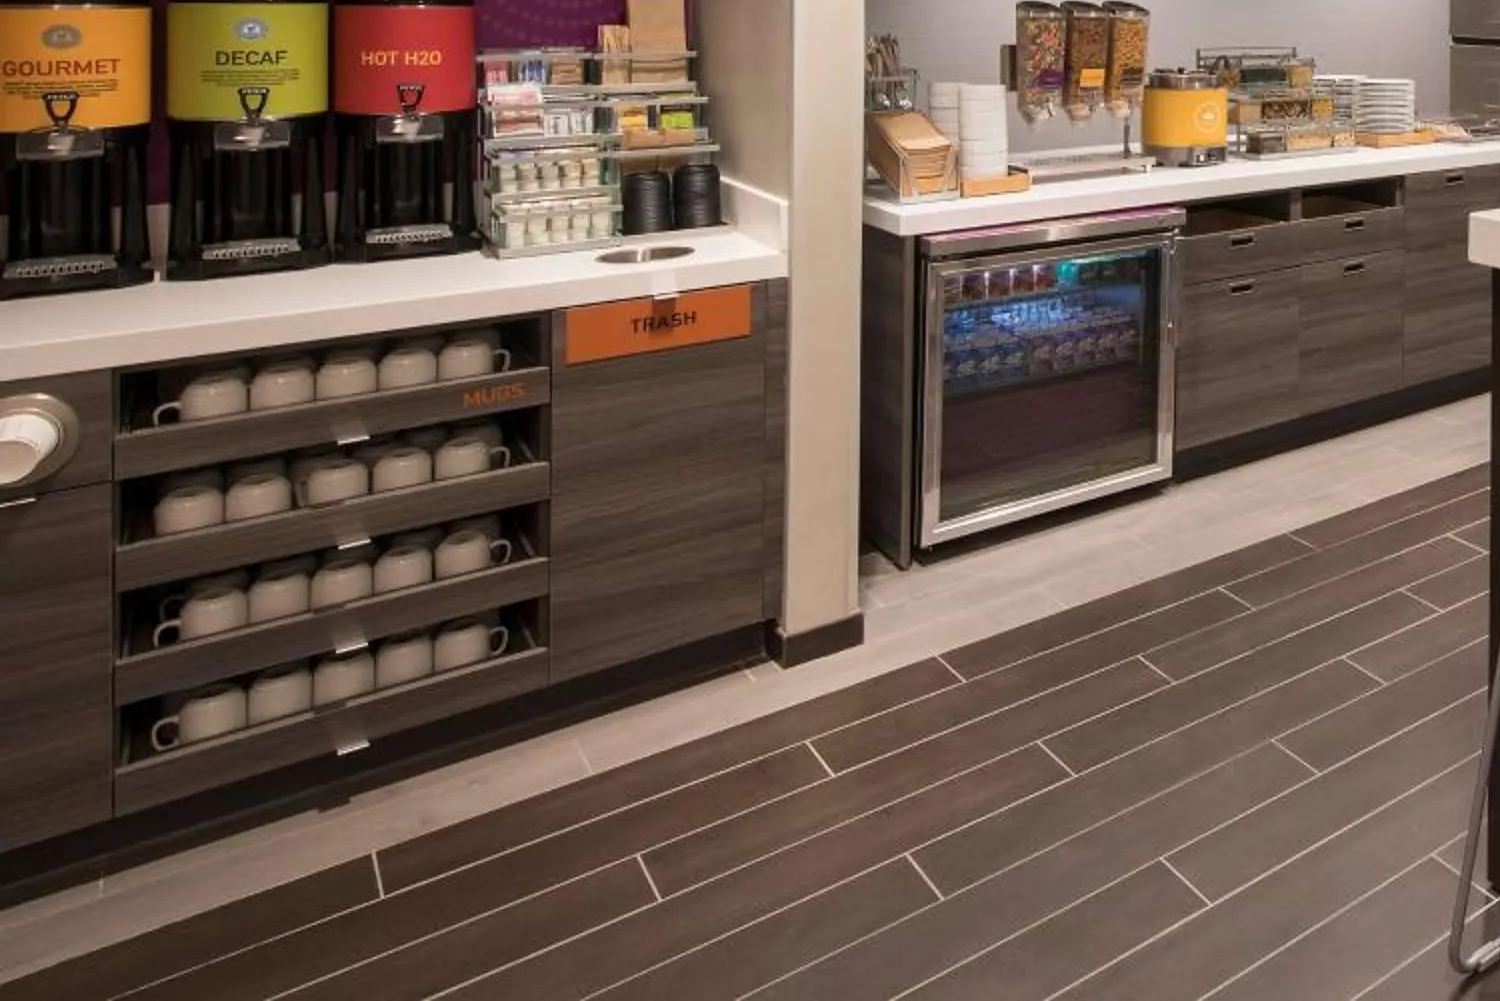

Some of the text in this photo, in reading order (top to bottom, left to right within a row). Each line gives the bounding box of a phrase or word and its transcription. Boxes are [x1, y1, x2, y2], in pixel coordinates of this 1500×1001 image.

[2, 58, 121, 77] GOURMET
[215, 50, 289, 67] DECAF
[361, 50, 400, 67] HOT
[630, 310, 697, 334] TRASH
[463, 382, 525, 408] MUGS
